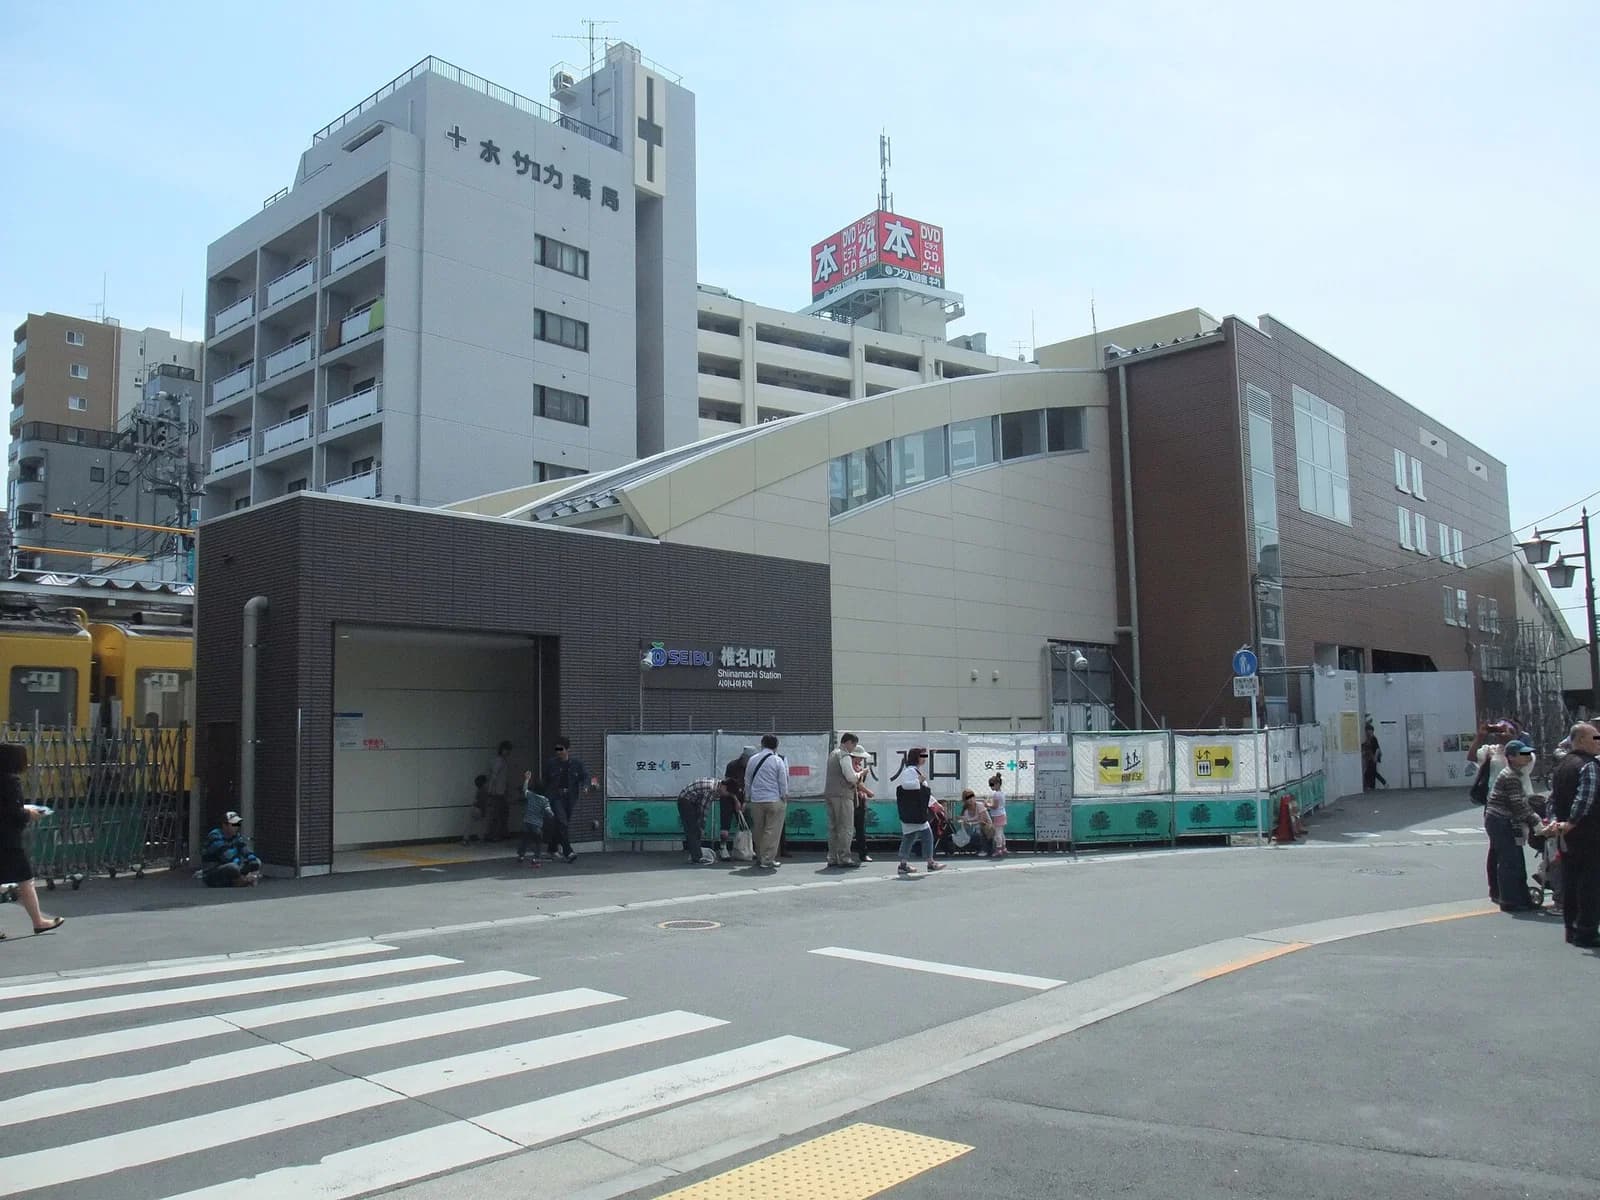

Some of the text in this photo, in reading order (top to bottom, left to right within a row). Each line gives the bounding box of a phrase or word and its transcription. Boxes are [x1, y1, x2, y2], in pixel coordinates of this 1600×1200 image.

[842, 226, 856, 248] DVD
[858, 228, 876, 258] 24
[883, 220, 916, 260] 本
[920, 225, 941, 243] DVD
[813, 243, 839, 283] 本
[924, 250, 939, 262] CD
[843, 260, 857, 276] CD
[667, 649, 714, 667] SEIBU
[721, 646, 777, 668] 椎名町駅
[717, 669, 782, 679] Shiinamachi Station
